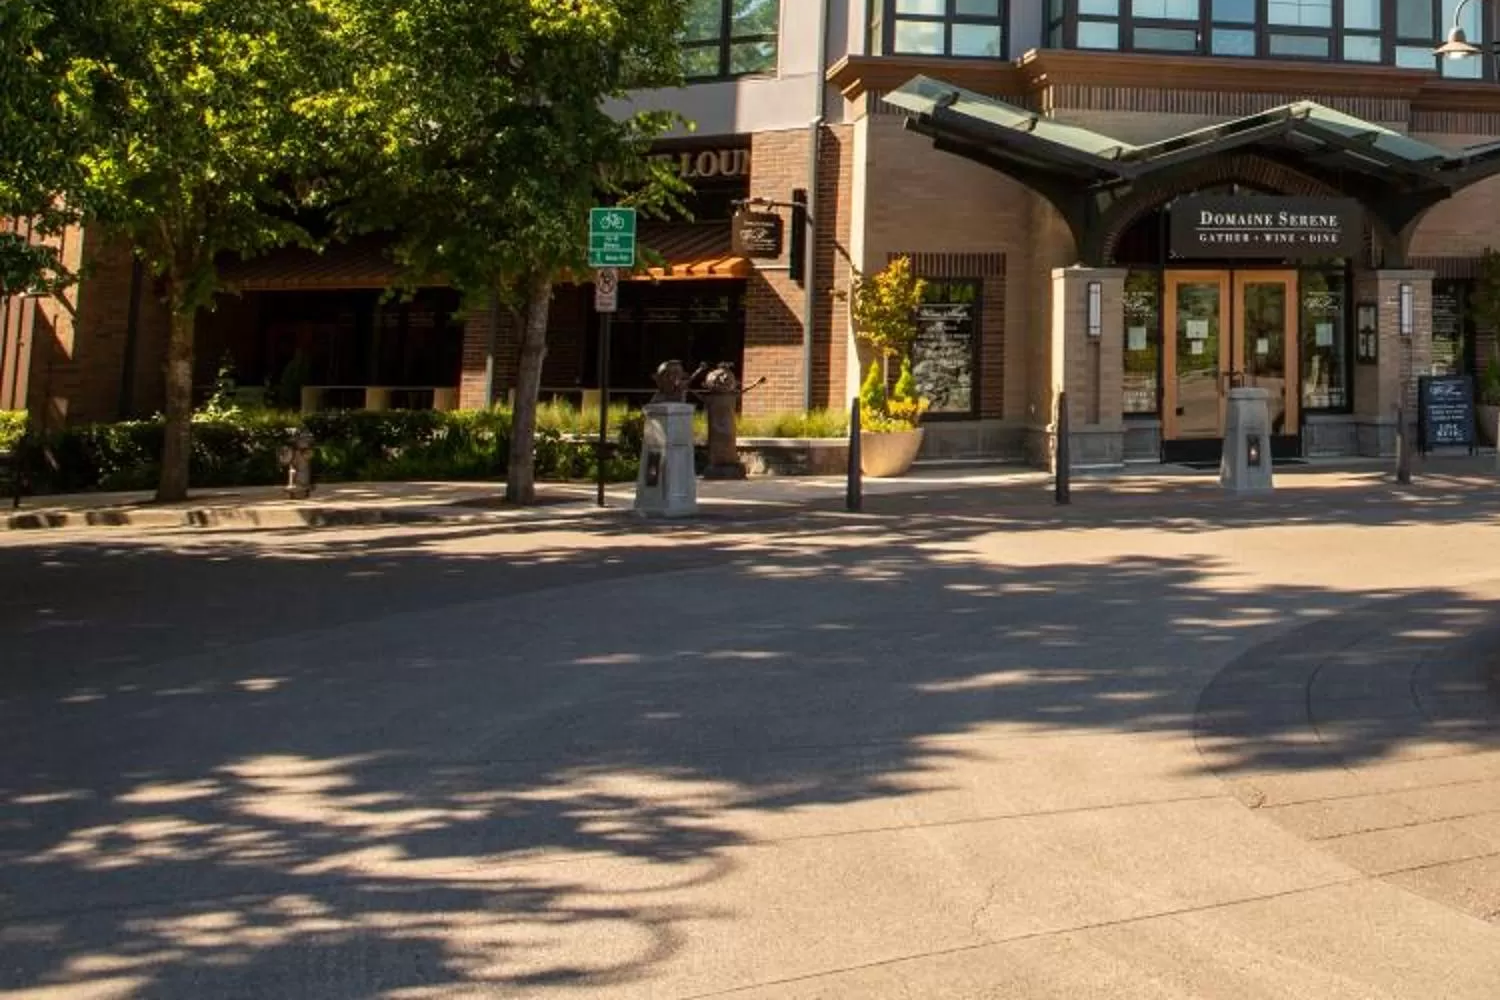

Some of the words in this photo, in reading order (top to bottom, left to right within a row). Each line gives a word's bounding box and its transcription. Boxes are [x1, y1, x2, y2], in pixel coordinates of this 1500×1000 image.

[1200, 211, 1273, 225] DOMAINE
[1278, 211, 1337, 227] SERENE
[1199, 233, 1249, 242] GATHER
[1264, 233, 1294, 242] WINE
[1309, 233, 1338, 243] DINE
